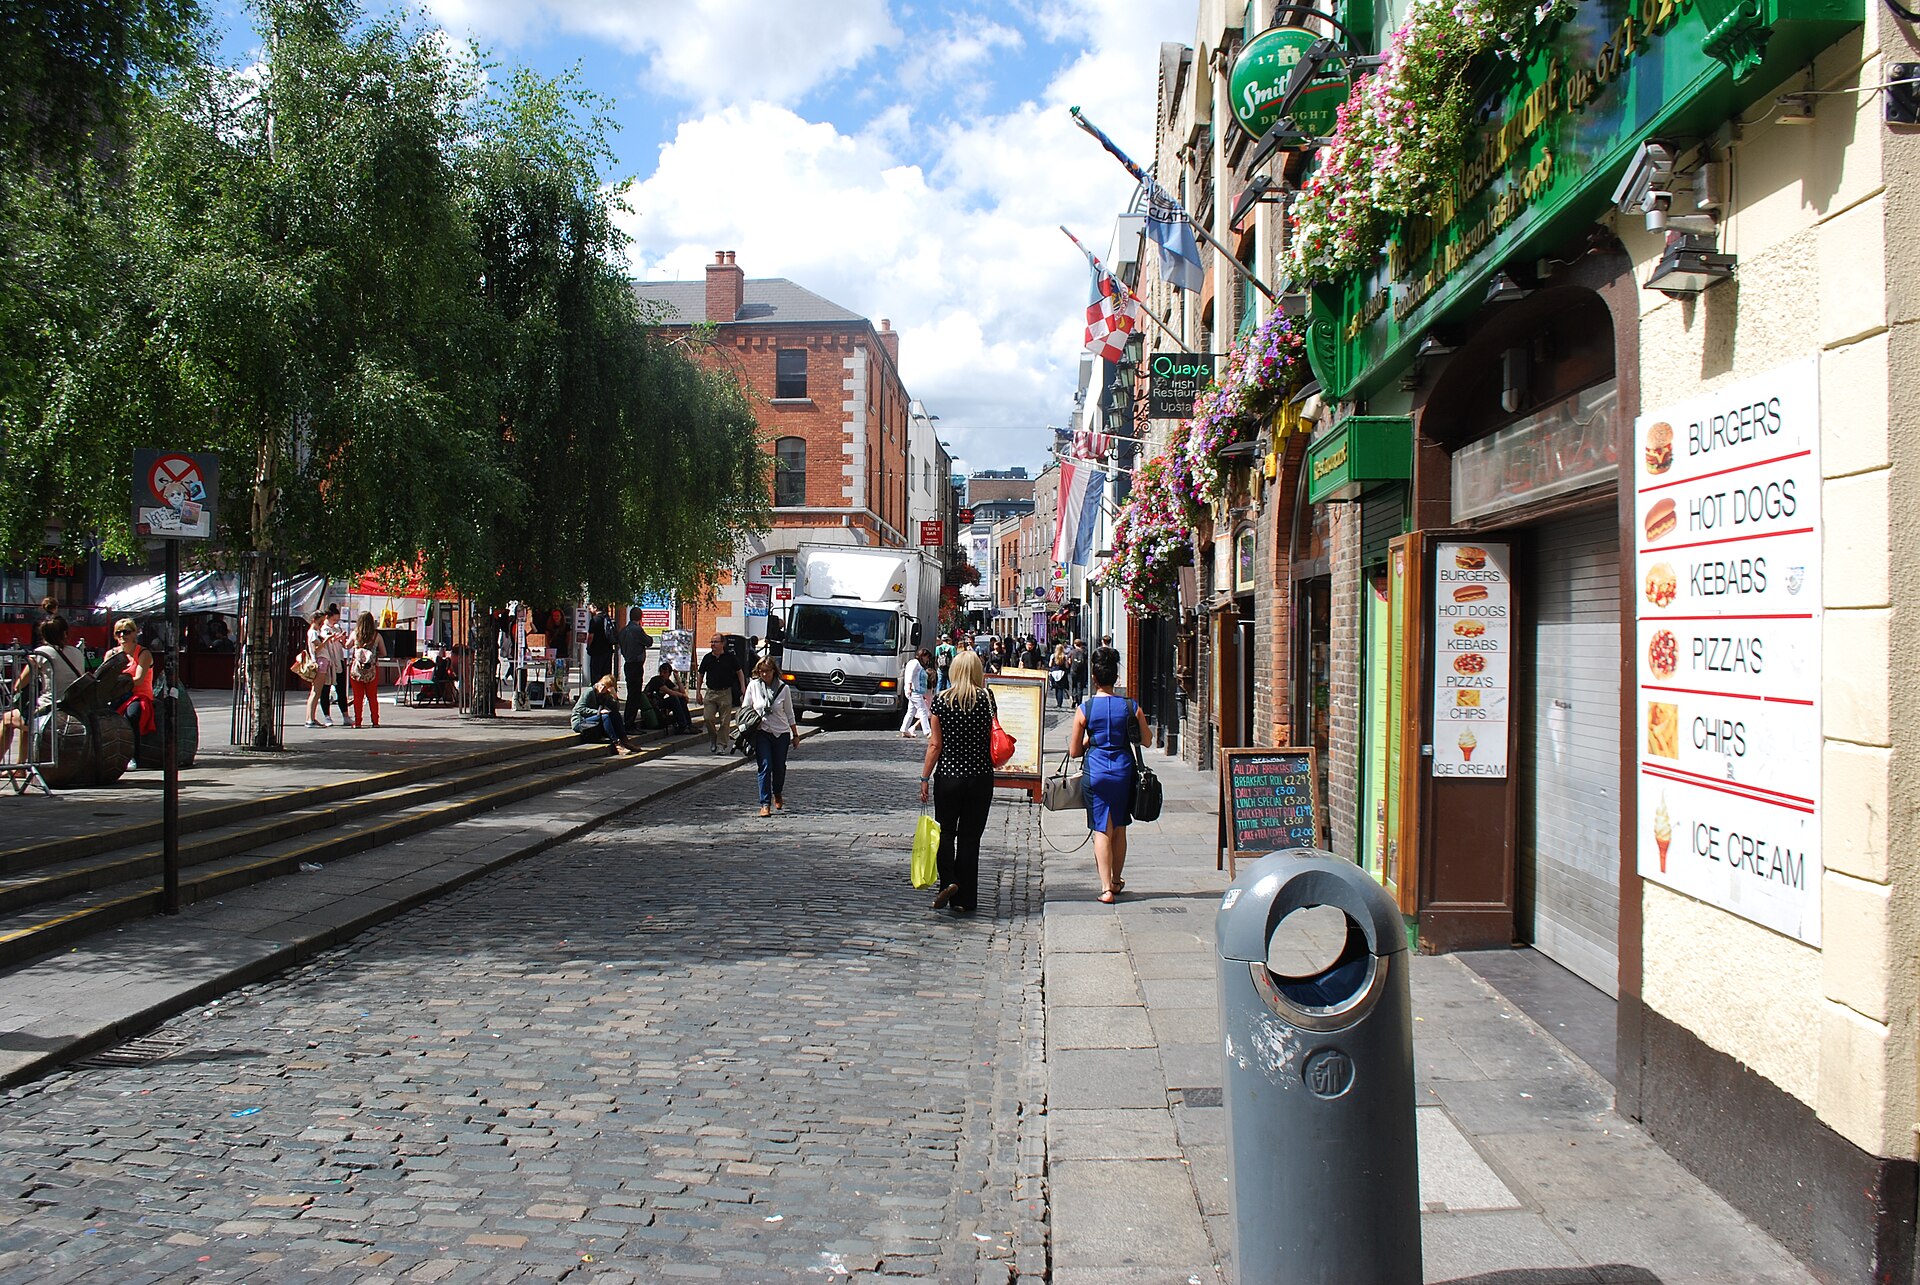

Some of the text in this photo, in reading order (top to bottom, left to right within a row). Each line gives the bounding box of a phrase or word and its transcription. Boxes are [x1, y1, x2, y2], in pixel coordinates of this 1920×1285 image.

[1595, 15, 1637, 83] 671
[1261, 110, 1329, 125] DRUGHT
[1148, 206, 1189, 222] CLIATH
[1153, 356, 1209, 378] Quays
[1160, 402, 1192, 413] Upsta
[1688, 397, 1781, 456] BURGERS
[1689, 478, 1797, 532] HOT DOGS
[40, 557, 75, 576] OPEN
[1440, 570, 1501, 582] BURGERS
[1690, 556, 1767, 597] KEBABS
[1438, 605, 1507, 617] HOT DOGS
[1447, 639, 1498, 651] KEBABS
[1692, 637, 1763, 674] PIZZA'S
[1446, 676, 1494, 688] PIZZA'S
[1449, 708, 1487, 719] CHIPS
[1692, 715, 1746, 758] CHIPS
[1246, 764, 1259, 774] DAY
[1262, 763, 1294, 774] BREAKFAST
[1434, 763, 1505, 776] ICE CREAM
[1234, 775, 1267, 787] BREAKFAST
[1269, 775, 1283, 785] ROLL
[1236, 797, 1256, 808] LUNCH
[1257, 796, 1283, 806] SPECIAL
[1236, 808, 1264, 819] CHICKEN
[1692, 820, 1805, 891] ICE CREAM
